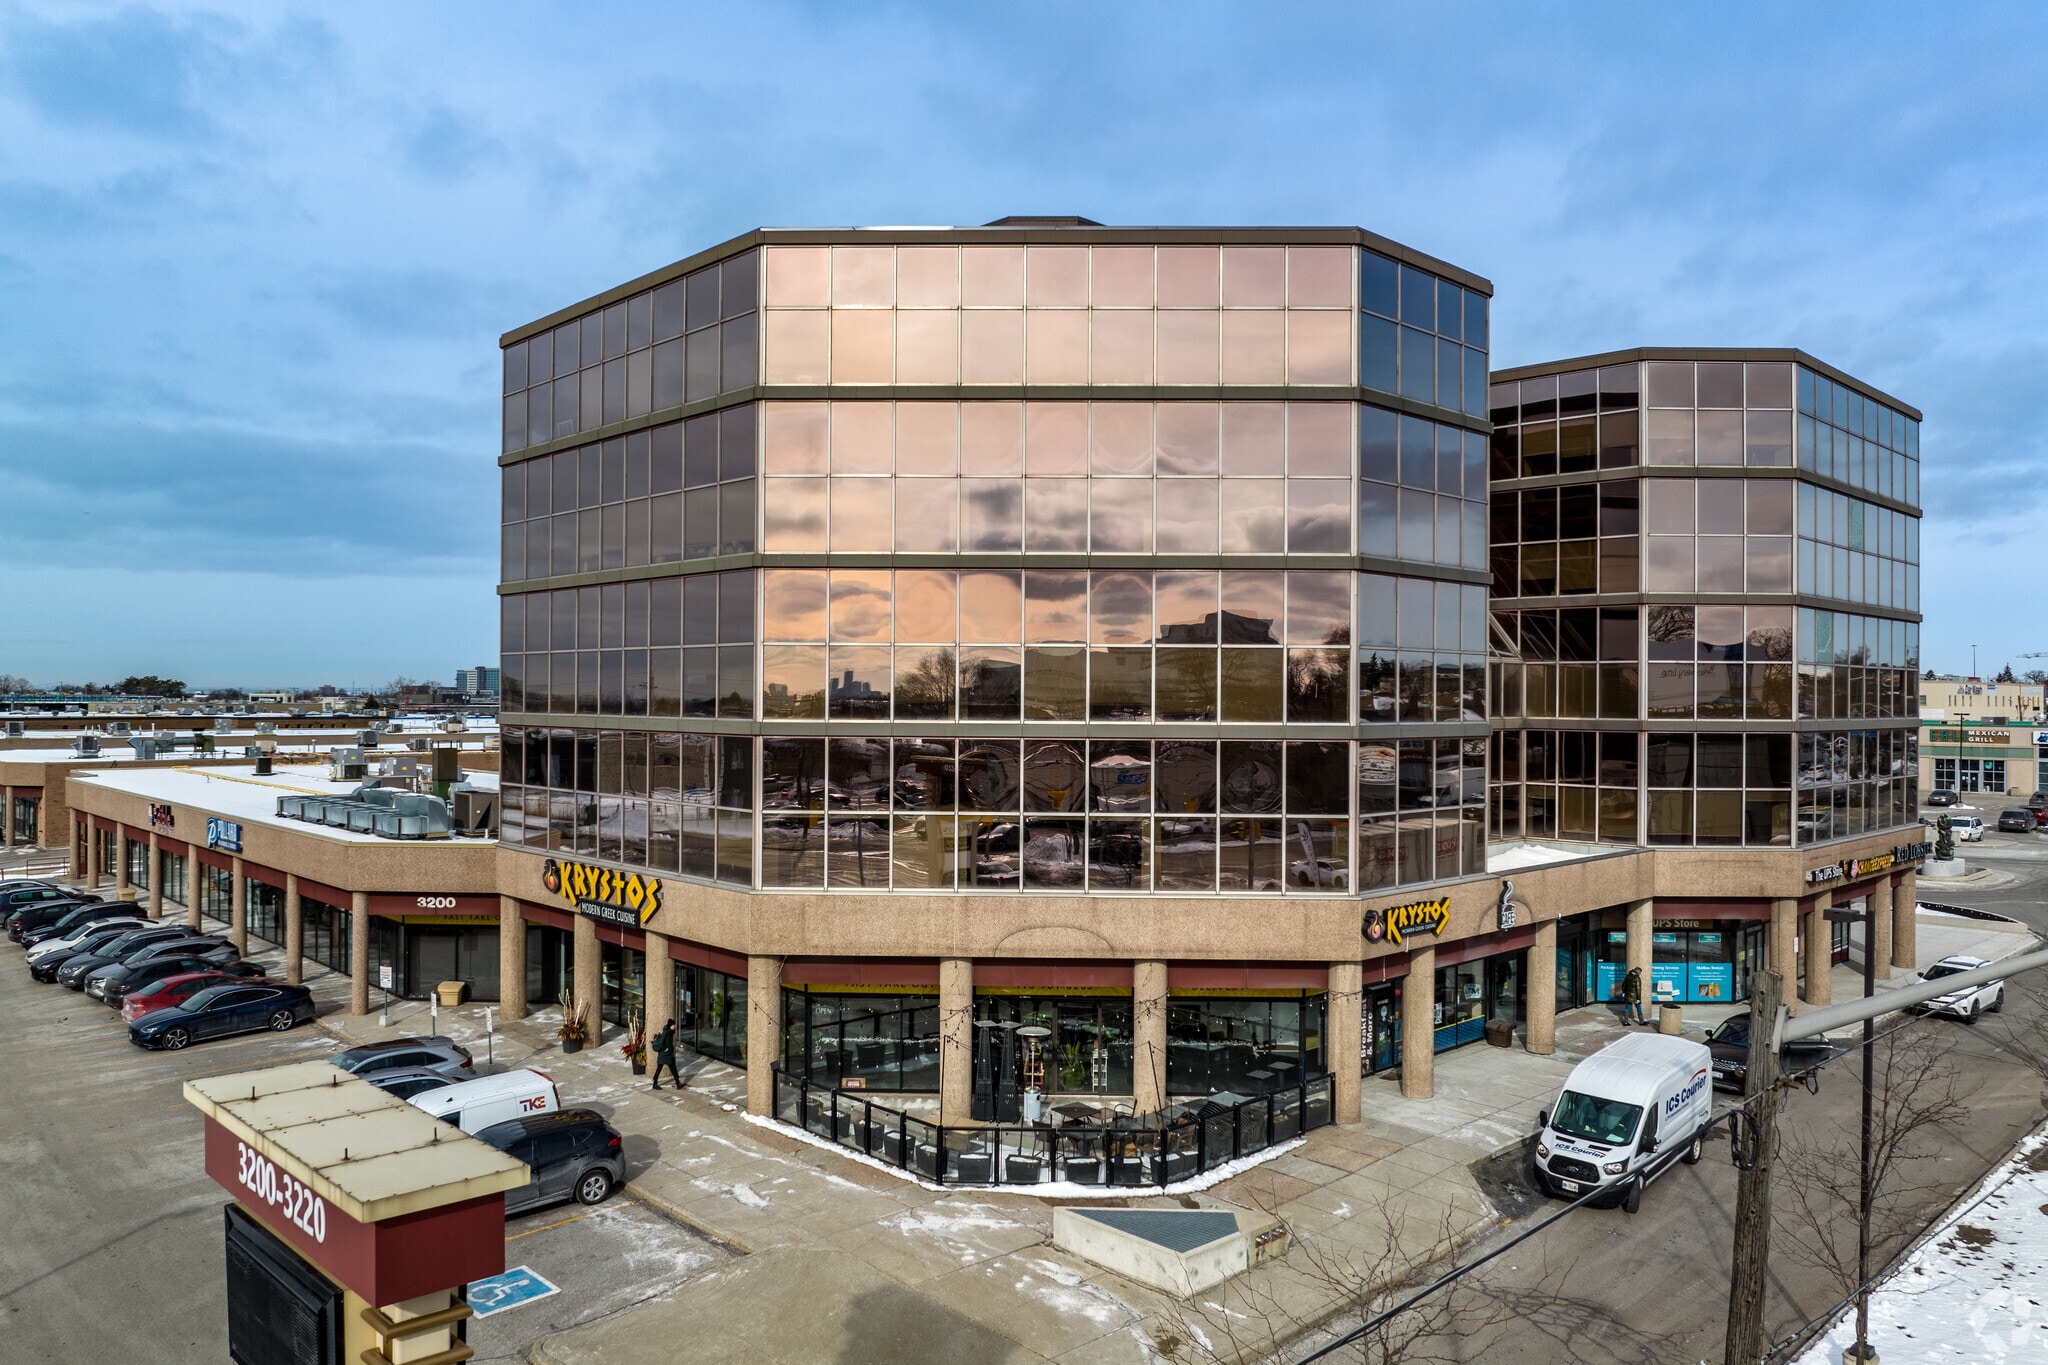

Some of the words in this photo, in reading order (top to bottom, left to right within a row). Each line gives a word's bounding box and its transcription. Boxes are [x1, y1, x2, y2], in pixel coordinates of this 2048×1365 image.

[1896, 846, 1910, 863] RED
[1815, 870, 1824, 882] The
[1824, 867, 1832, 880] UPS
[1832, 864, 1843, 877] Store
[560, 862, 659, 924] KRYSTOS
[417, 897, 456, 908] 3200
[581, 902, 601, 916] MODERN
[601, 905, 616, 920] GREEK
[617, 910, 635, 925] CUISINE
[1387, 897, 1451, 944] KRYSTOS
[1674, 919, 1699, 928] Store
[815, 1008, 832, 1016] OPEN
[1367, 1046, 1373, 1055] &
[519, 1095, 546, 1112] TKE
[1665, 1093, 1680, 1115] ICS
[1681, 1075, 1707, 1103] Courier
[1554, 1142, 1570, 1150] ICS
[1571, 1146, 1606, 1159] Courier
[238, 1141, 326, 1244] 3200-3220
